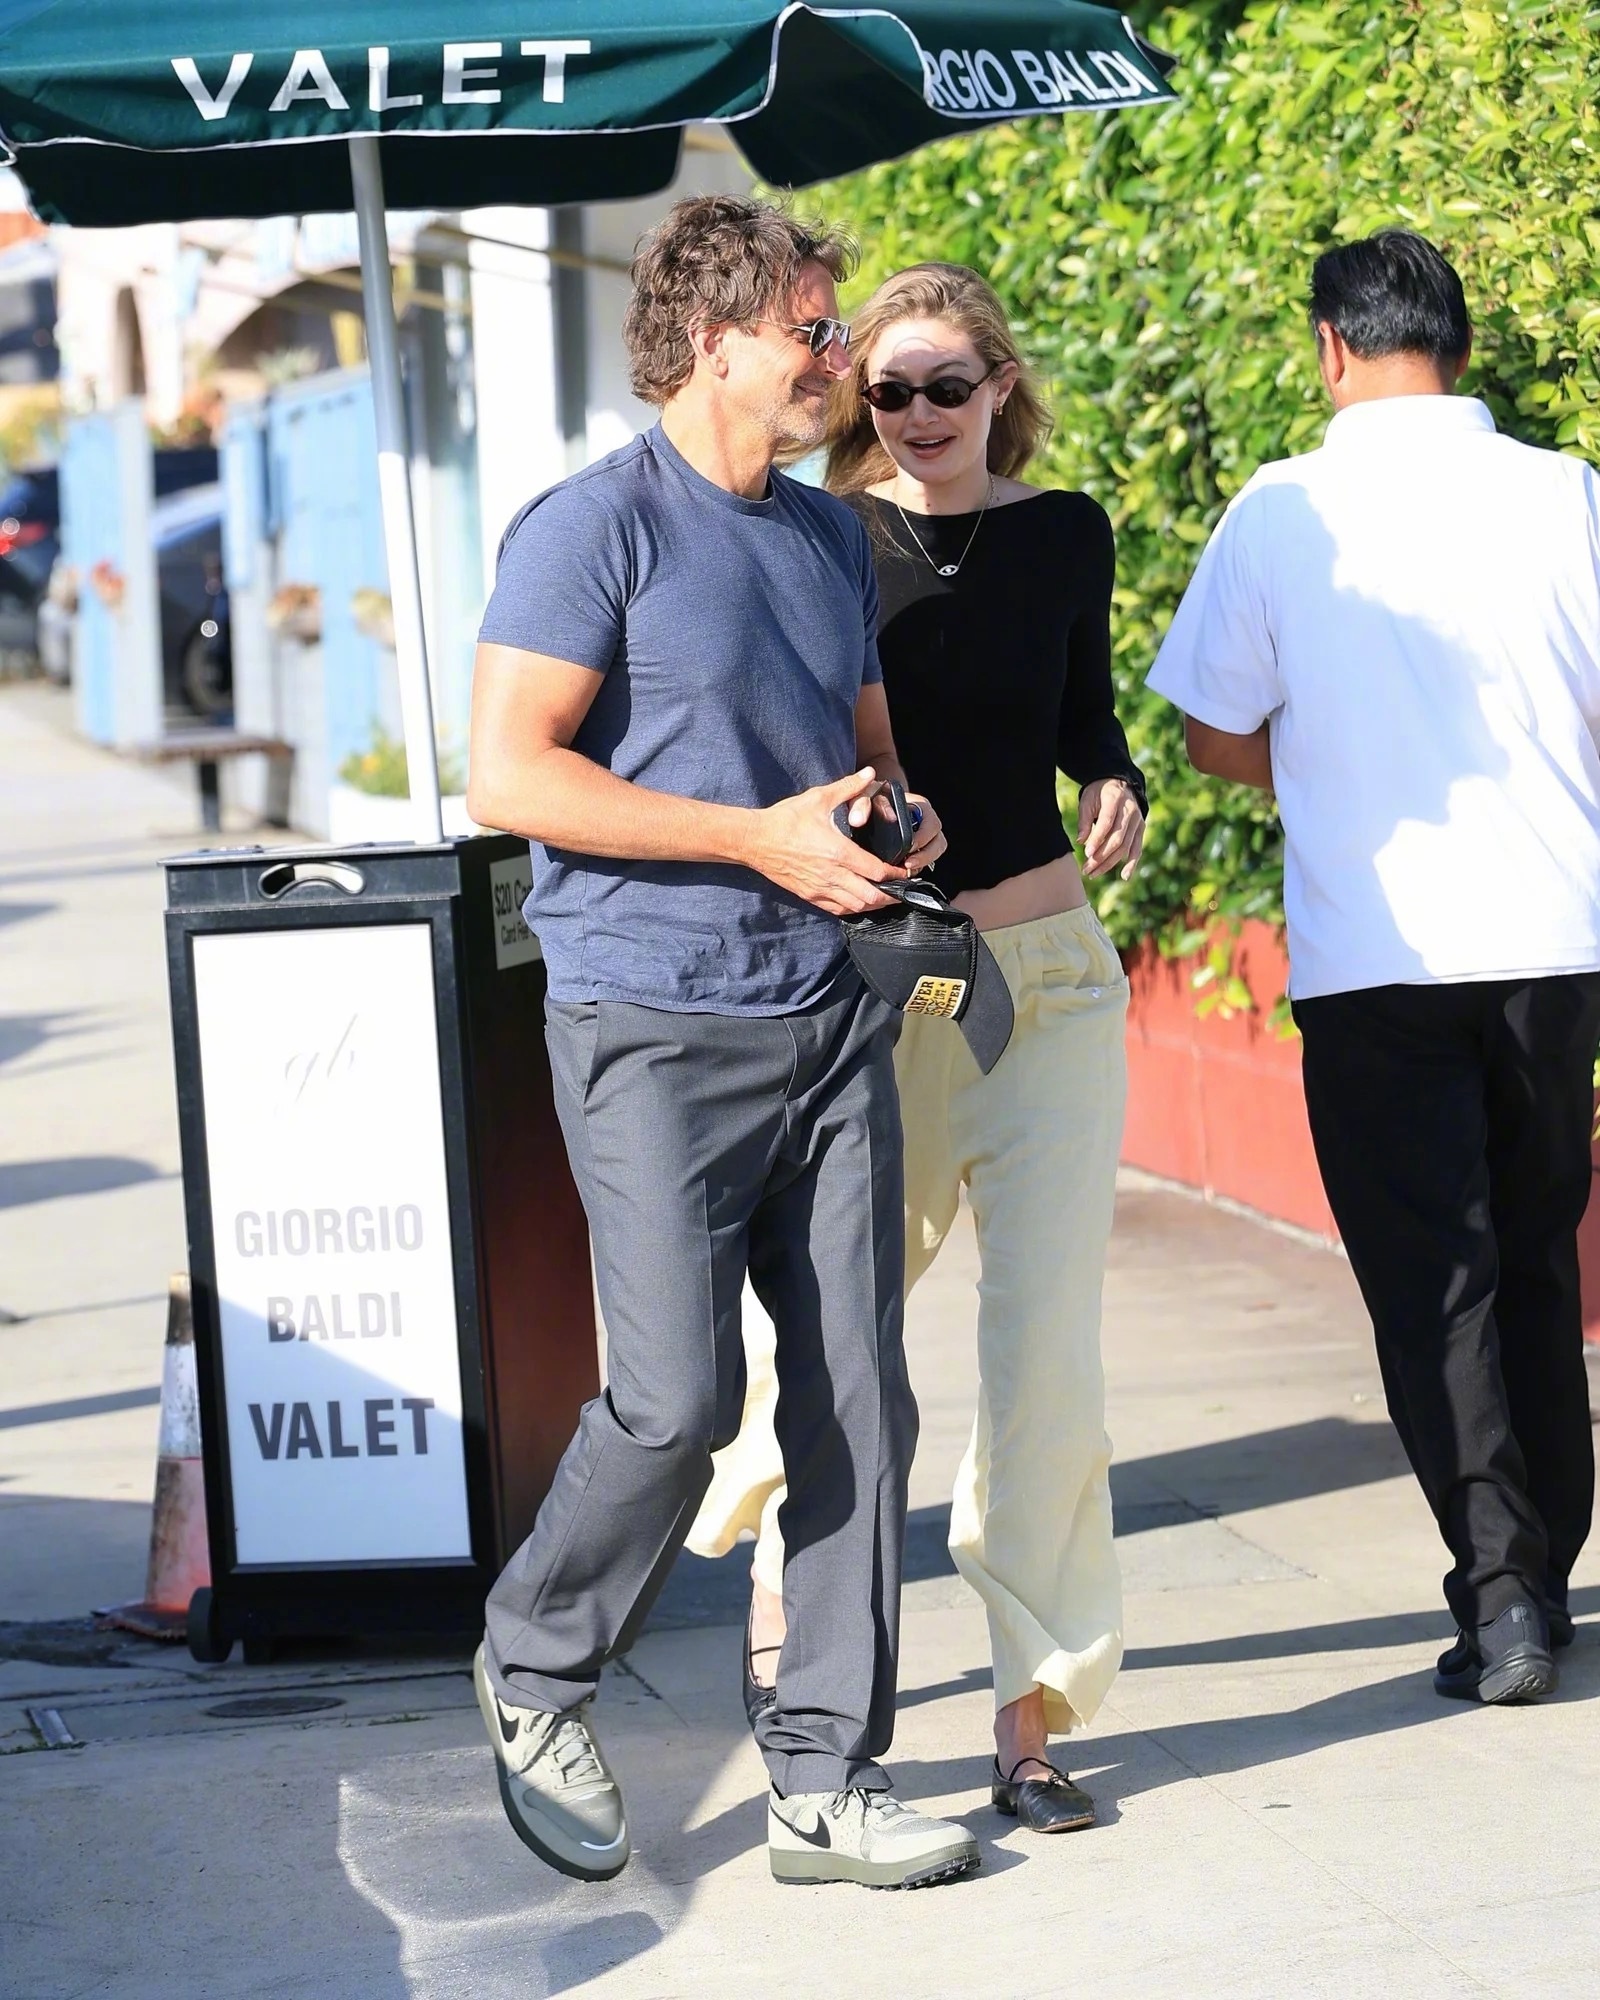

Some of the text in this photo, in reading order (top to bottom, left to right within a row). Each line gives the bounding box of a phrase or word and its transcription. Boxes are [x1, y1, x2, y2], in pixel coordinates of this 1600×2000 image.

[171, 40, 591, 121] VALET
[1011, 50, 1158, 104] BALDI
[234, 1204, 423, 1258] GIORGIO
[267, 1292, 403, 1343] BALDI
[248, 1398, 435, 1460] VALET
